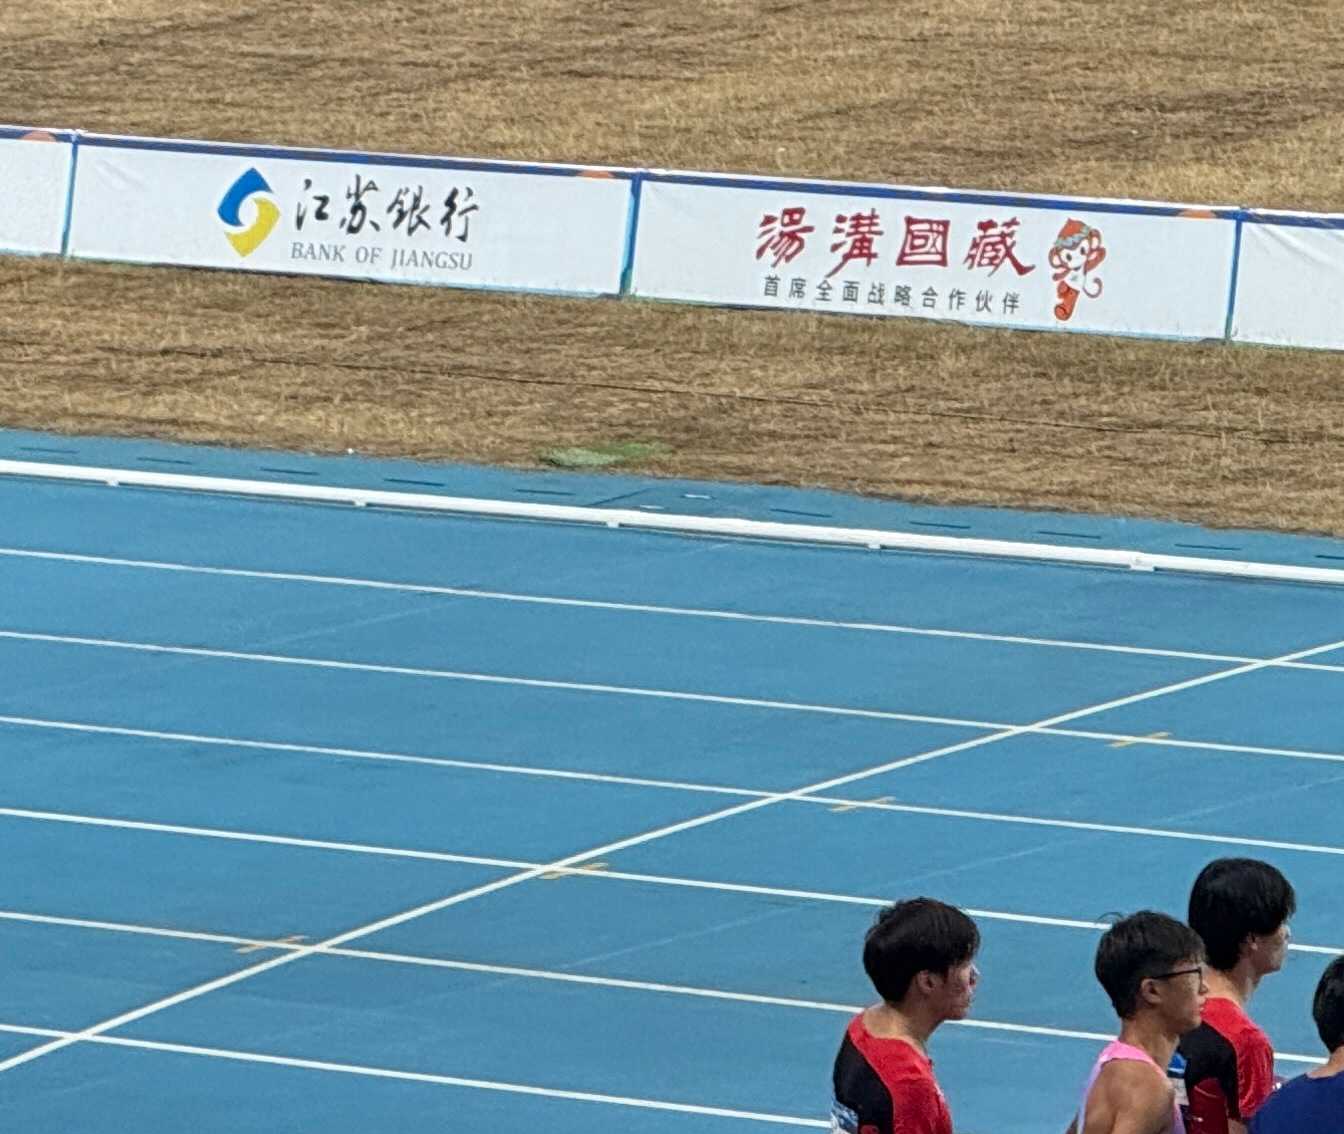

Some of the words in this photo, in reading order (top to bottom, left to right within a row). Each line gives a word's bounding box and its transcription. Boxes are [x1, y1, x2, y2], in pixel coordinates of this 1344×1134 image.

[295, 174, 479, 242] 江苏银行
[291, 241, 346, 262] BANK
[355, 246, 383, 264] OF
[390, 248, 473, 271] JIANGSU
[764, 275, 1021, 316] 首席全面战略合作伙伴
